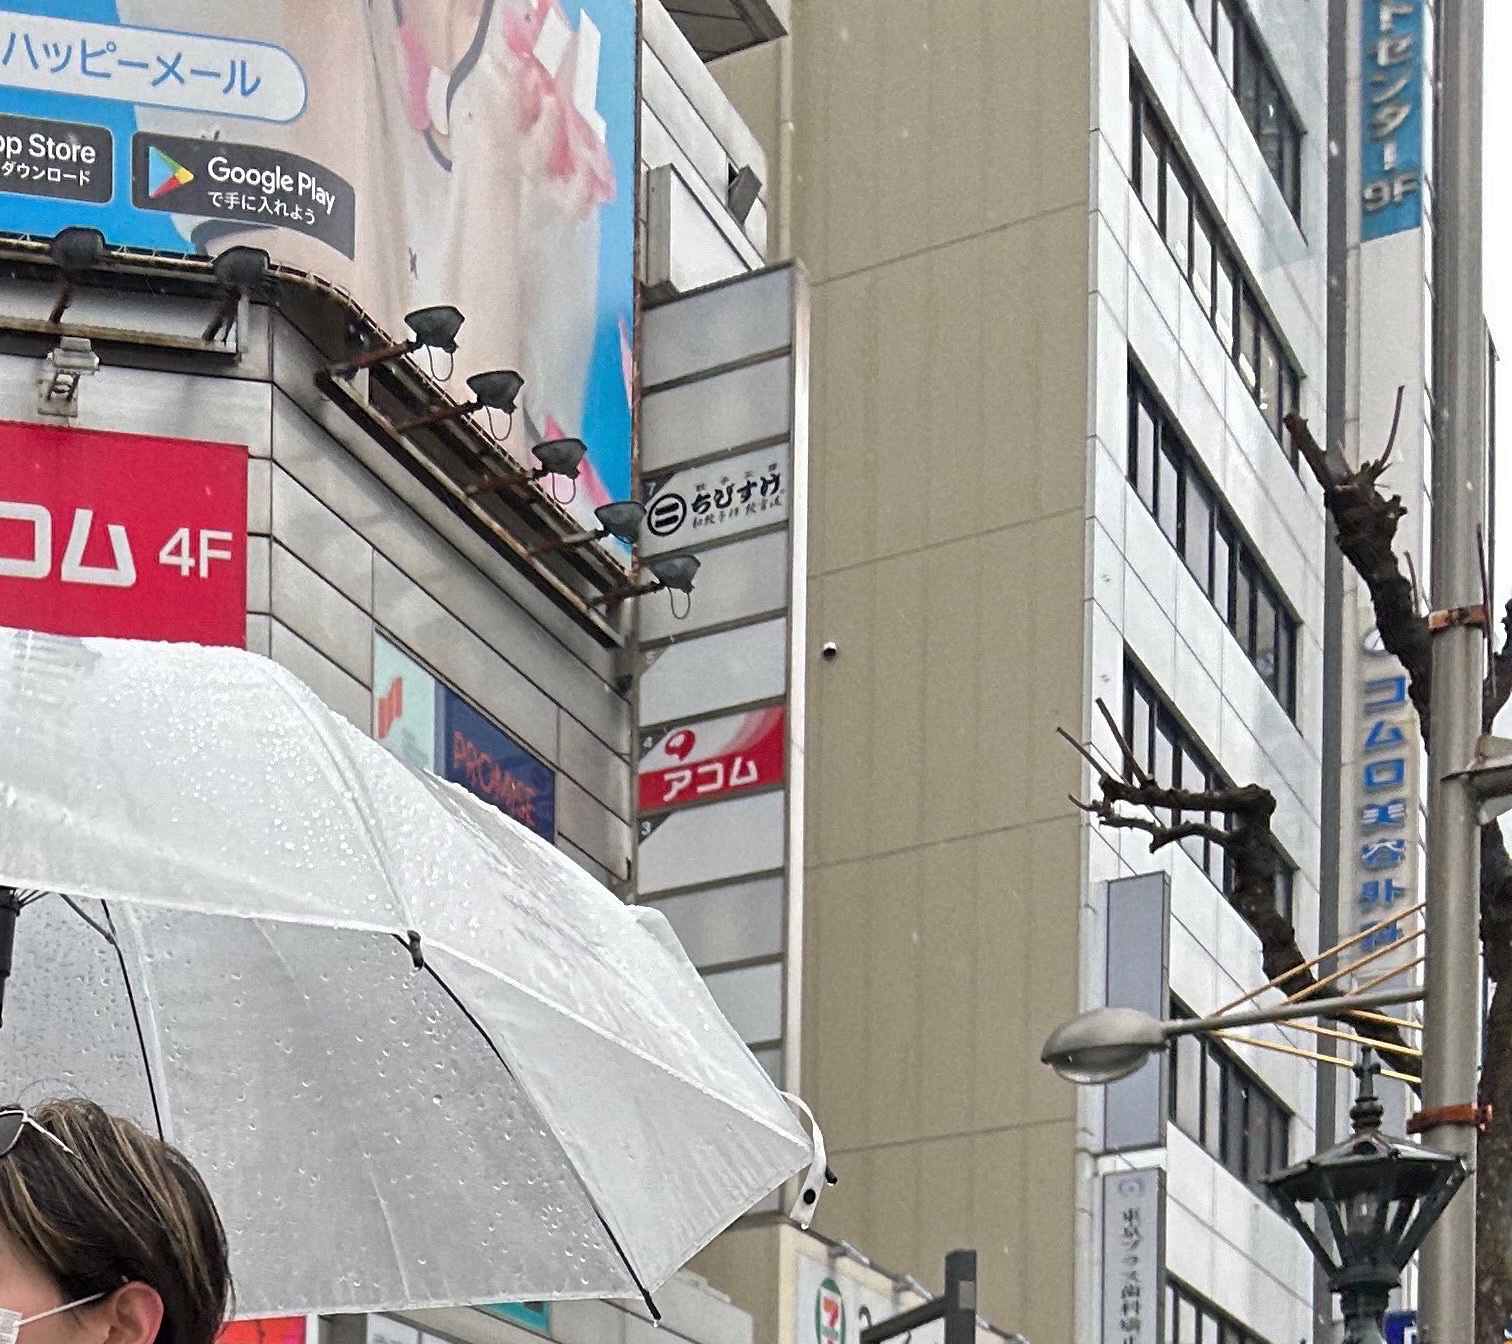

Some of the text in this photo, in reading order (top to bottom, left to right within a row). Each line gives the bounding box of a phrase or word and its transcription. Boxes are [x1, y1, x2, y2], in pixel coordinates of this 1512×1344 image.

[2, 32, 261, 97] ハッピーメール
[29, 133, 96, 164] Store
[207, 156, 336, 215] Google Play
[208, 190, 316, 225] で手に入れよう
[158, 526, 234, 579] 4F
[663, 757, 759, 802] アコム
